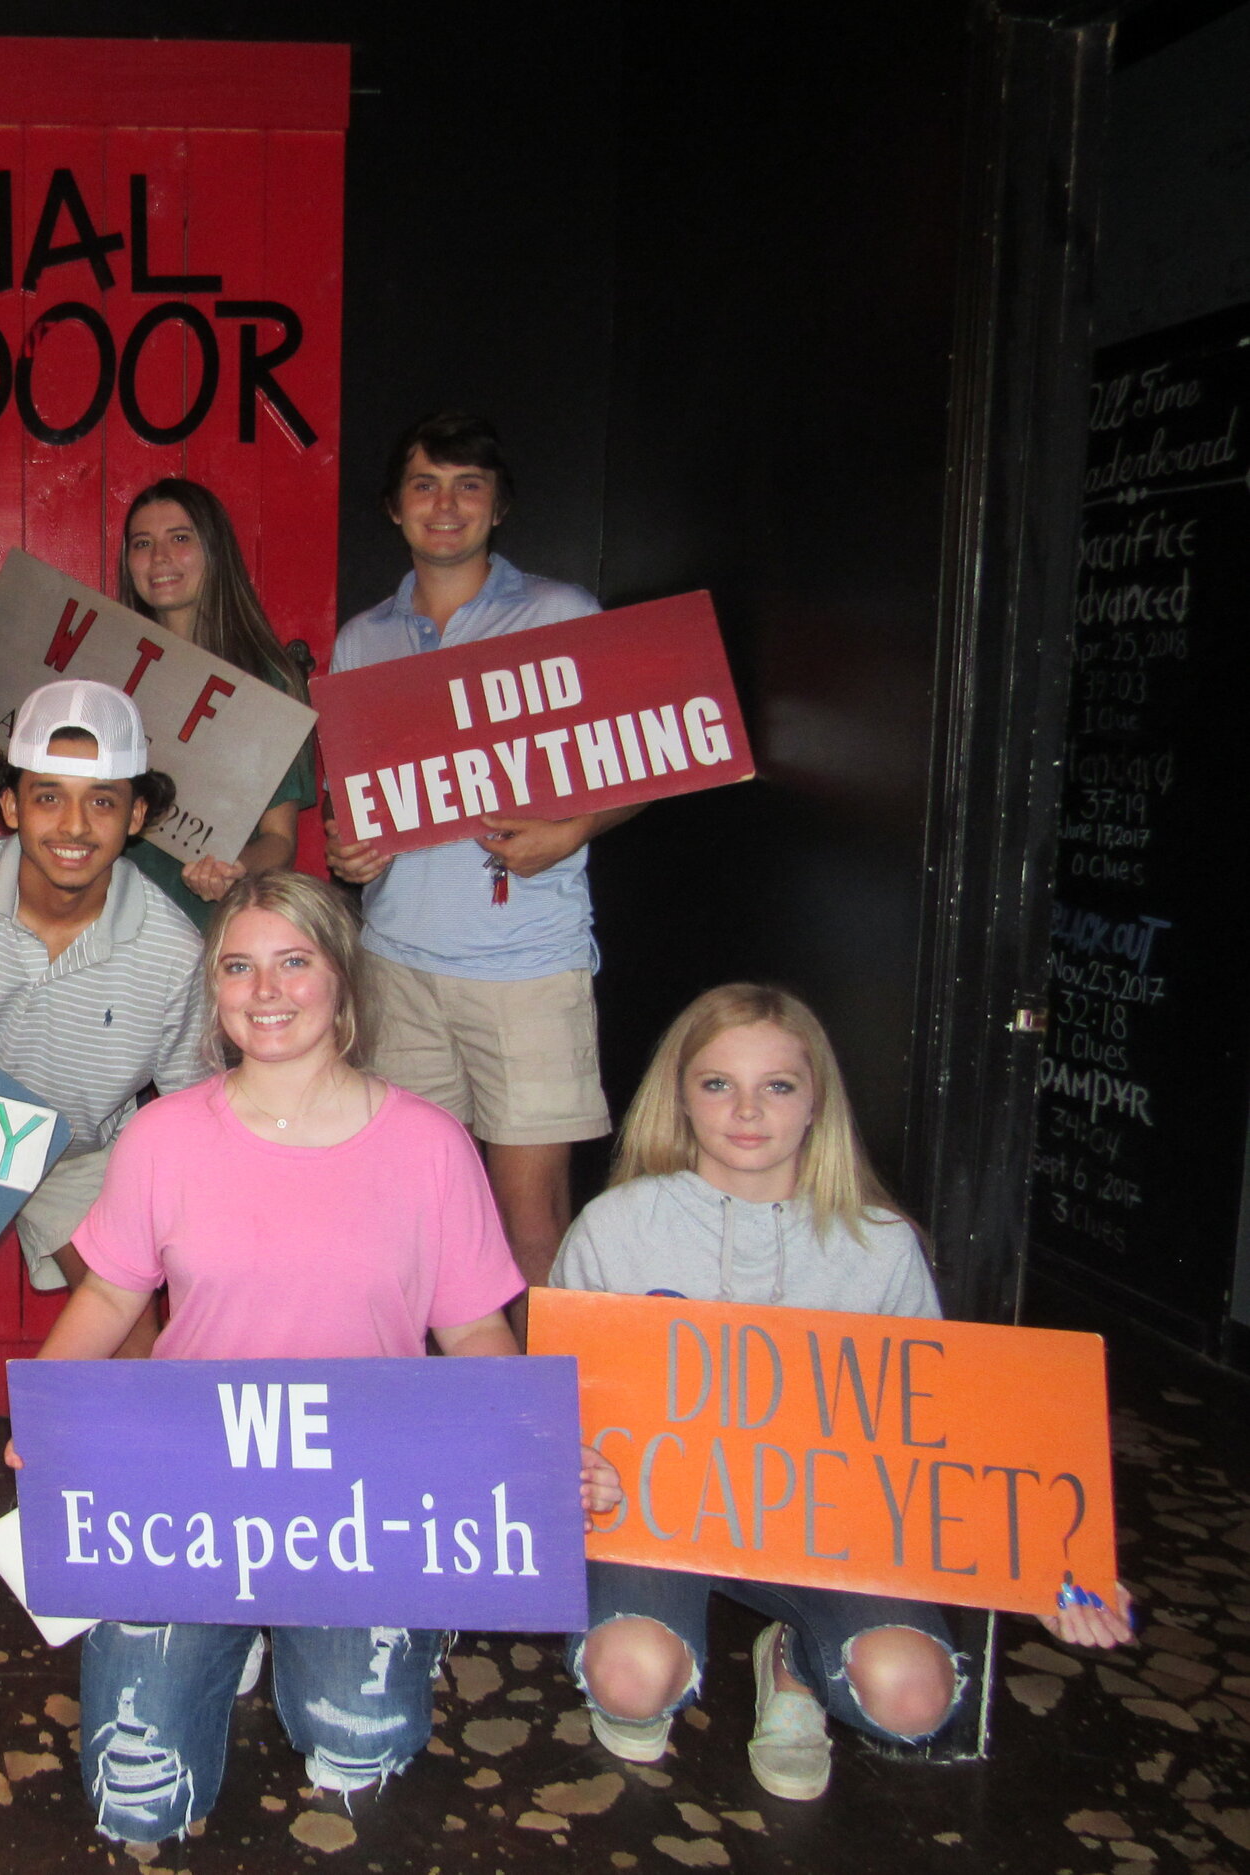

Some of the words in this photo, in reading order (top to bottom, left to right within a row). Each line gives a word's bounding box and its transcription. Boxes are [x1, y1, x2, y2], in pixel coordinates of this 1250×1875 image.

[1133, 361, 1201, 418] Time
[1085, 405, 1239, 494] aderboard
[1075, 567, 1190, 626] dvanced
[448, 677, 473, 731] I
[481, 656, 582, 724] DID
[344, 696, 732, 842] EVERYTHING
[1080, 788, 1146, 825] 37:19
[1056, 988, 1128, 1041] 32:18
[217, 1383, 332, 1469] WE
[666, 1319, 783, 1429] DID
[807, 1331, 946, 1449] WE
[61, 1478, 539, 1601] Escaped-ish
[580, 1427, 849, 1561] SCAPE
[873, 1453, 1086, 1584] YET?
